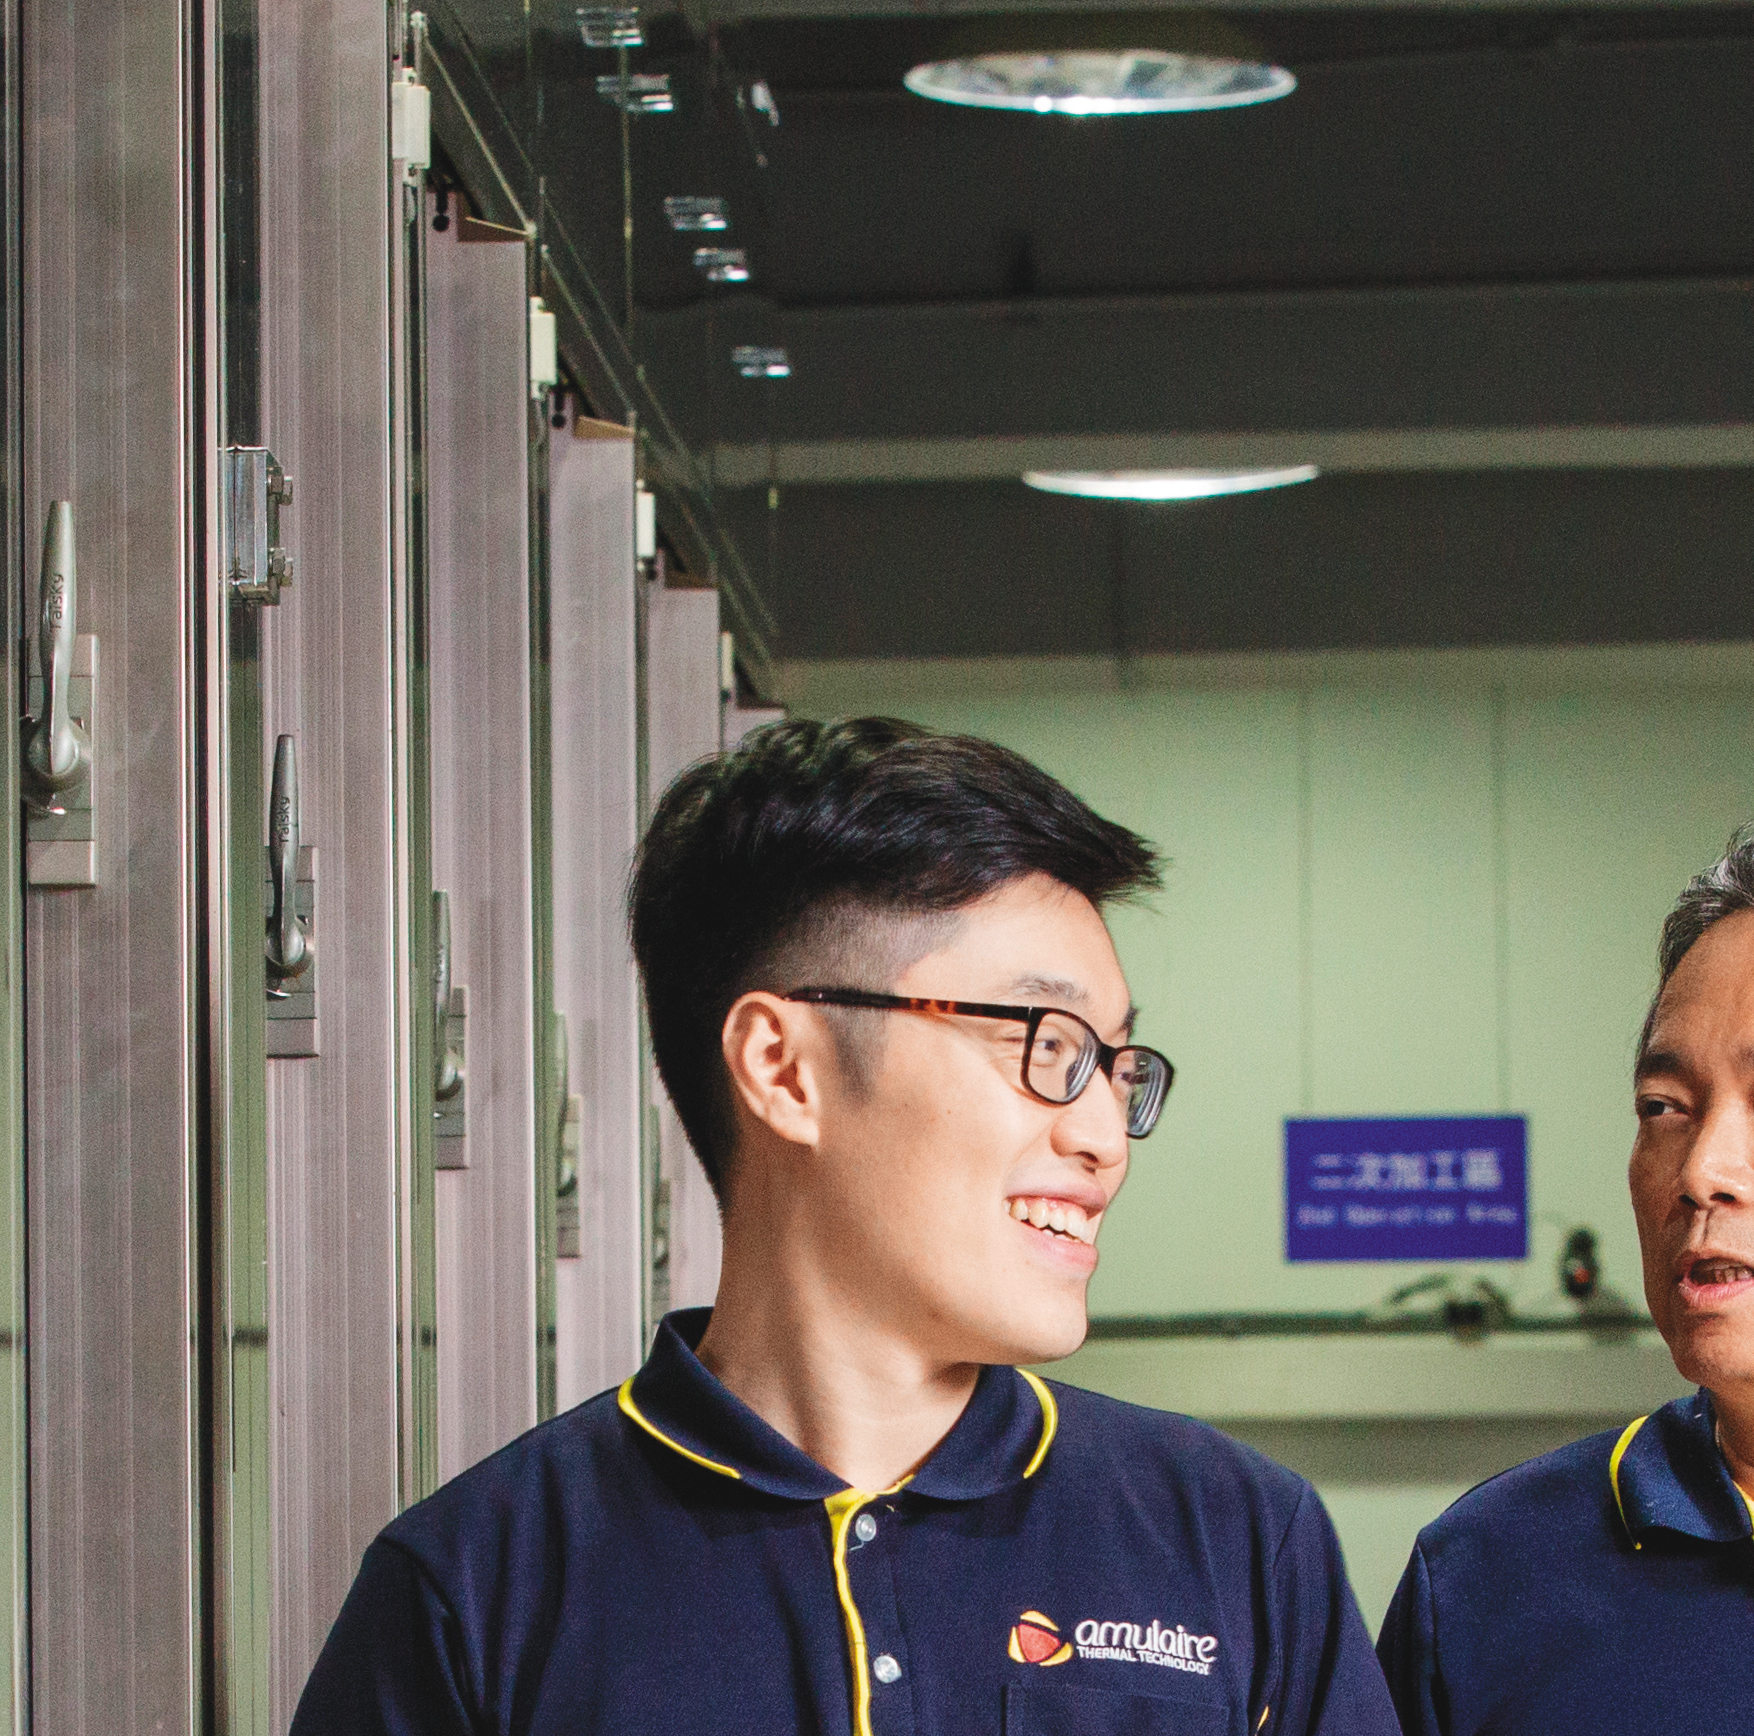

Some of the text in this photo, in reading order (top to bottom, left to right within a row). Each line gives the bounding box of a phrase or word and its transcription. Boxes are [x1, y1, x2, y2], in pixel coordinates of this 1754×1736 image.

[1075, 1619, 1218, 1663] amulaire
[1077, 1646, 1211, 1676] THERMAL TECHNOLOGY
